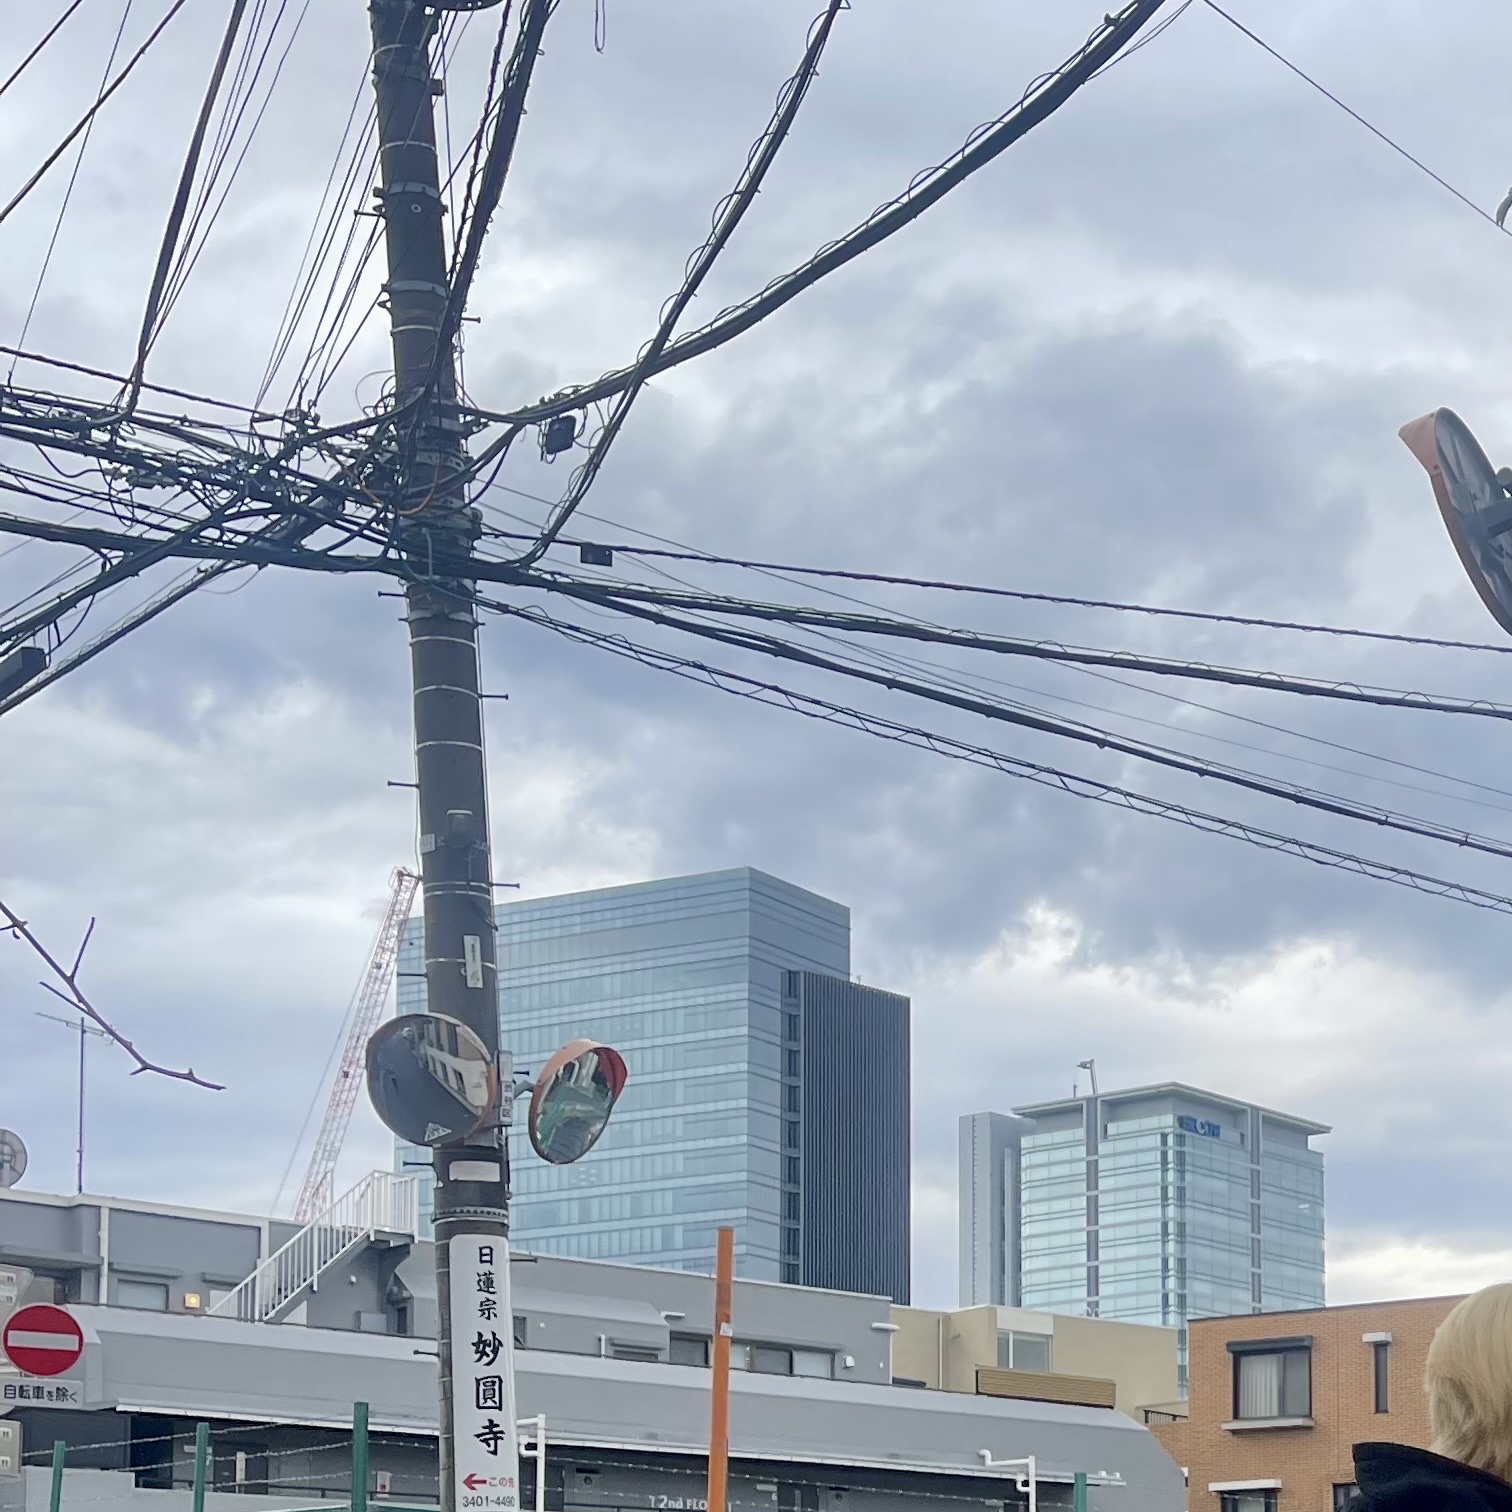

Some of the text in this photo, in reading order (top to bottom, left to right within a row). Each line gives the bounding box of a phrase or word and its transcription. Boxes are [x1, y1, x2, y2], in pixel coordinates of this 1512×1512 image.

[471, 1245, 506, 1456] 日蓮宗 妙圓寺
[4, 1383, 78, 1403] 自転車を除く
[489, 1476, 515, 1488] この先
[659, 1495, 708, 1511] 2nd FLO
